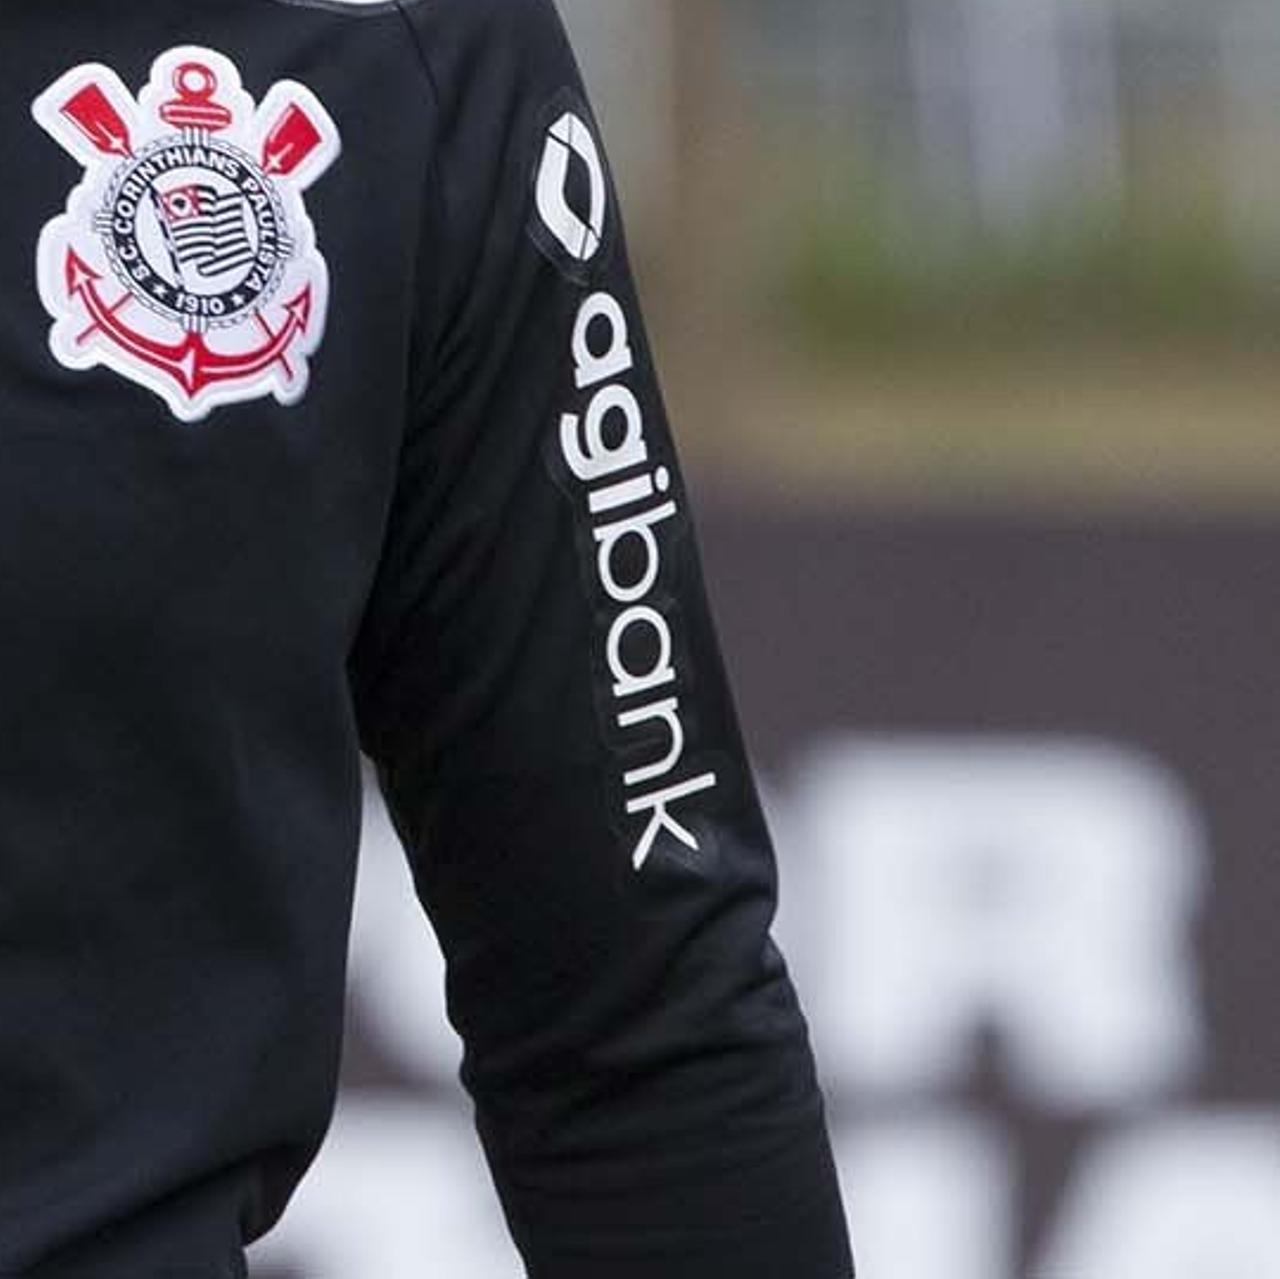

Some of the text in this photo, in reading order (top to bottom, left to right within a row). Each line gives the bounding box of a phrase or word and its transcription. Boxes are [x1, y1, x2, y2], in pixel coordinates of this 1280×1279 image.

[242, 179, 276, 291] PAULISTA
[175, 294, 225, 314] 1910
[560, 292, 716, 871] agibank
